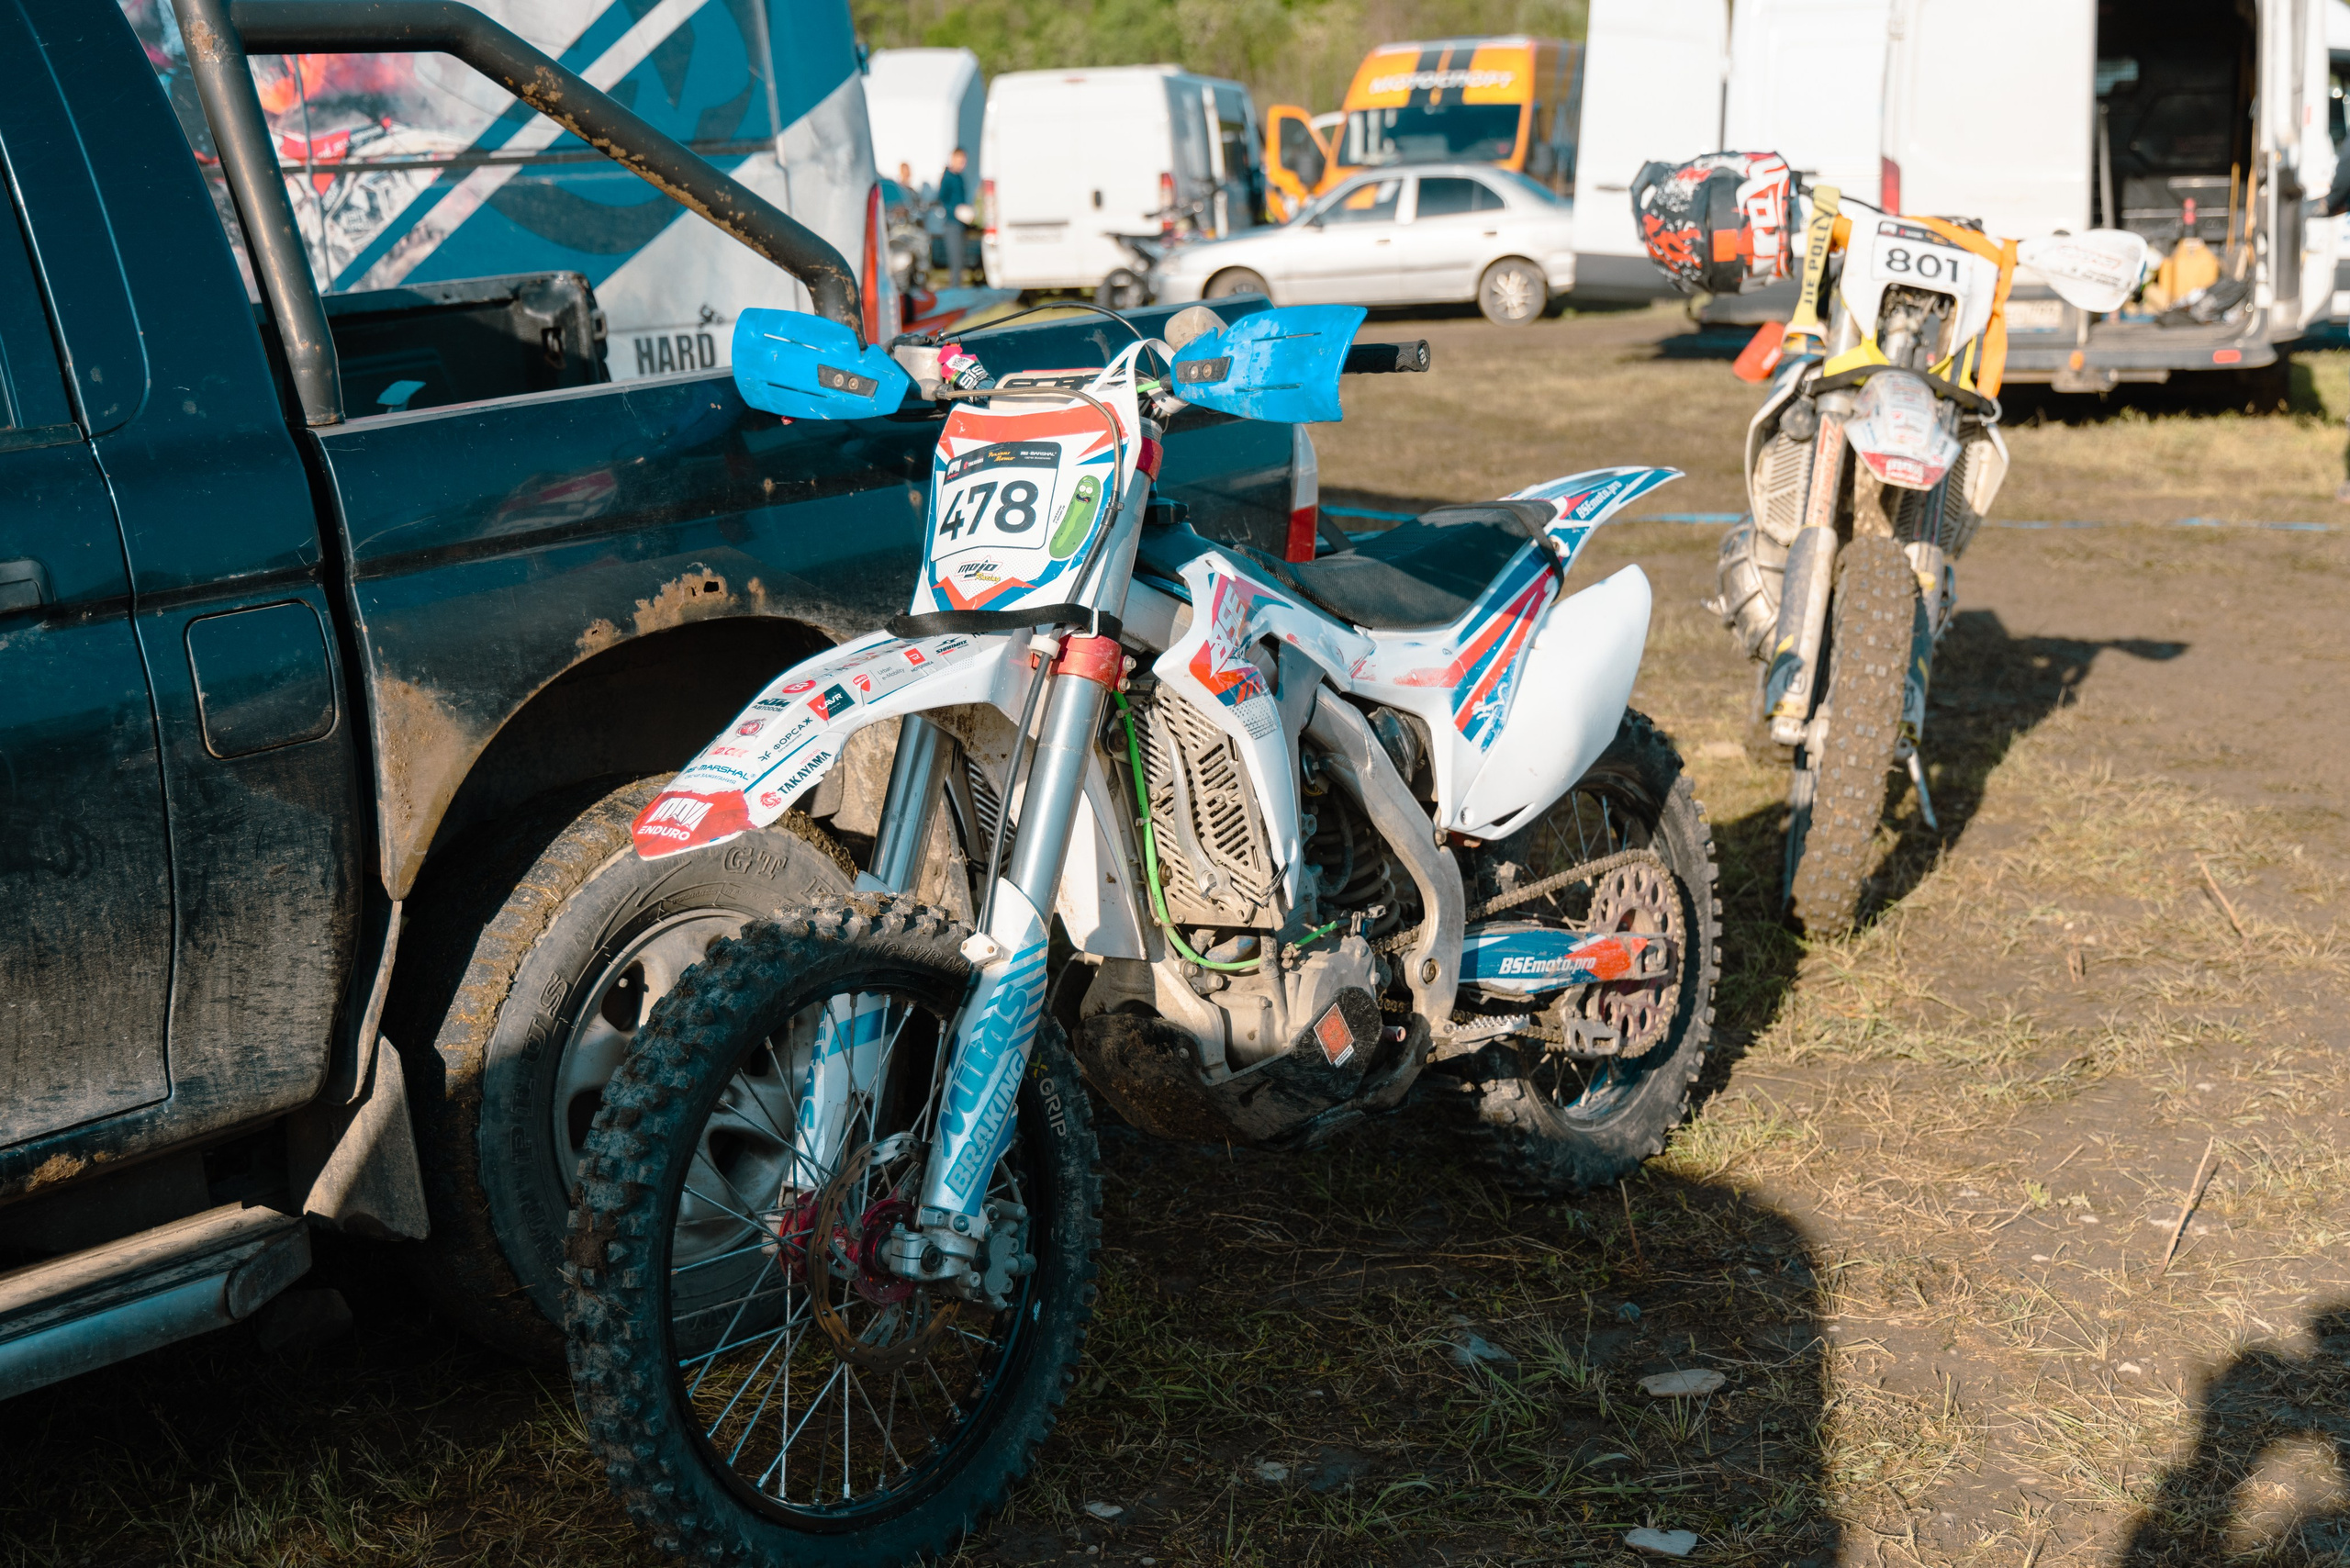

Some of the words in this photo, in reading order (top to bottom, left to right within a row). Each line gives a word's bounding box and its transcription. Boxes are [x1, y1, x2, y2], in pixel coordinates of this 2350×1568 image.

[1807, 209, 1835, 272] POLLY
[1886, 247, 1960, 284] 801
[634, 333, 716, 375] HARD
[939, 480, 1040, 542] 478
[1575, 480, 1623, 520] BSEmoto.pro
[877, 666, 892, 676] Urban
[881, 667, 906, 681] e-Mobility
[756, 698, 791, 707] KTM
[817, 693, 843, 711] LAVR
[773, 716, 813, 751] ФОРСАЖ
[777, 751, 833, 795] TAKAYAMA
[637, 825, 691, 841] ENDURO
[724, 846, 788, 879] GT
[1498, 957, 1596, 975] BSEmoto.pro
[946, 1050, 1025, 1196] BRAKING
